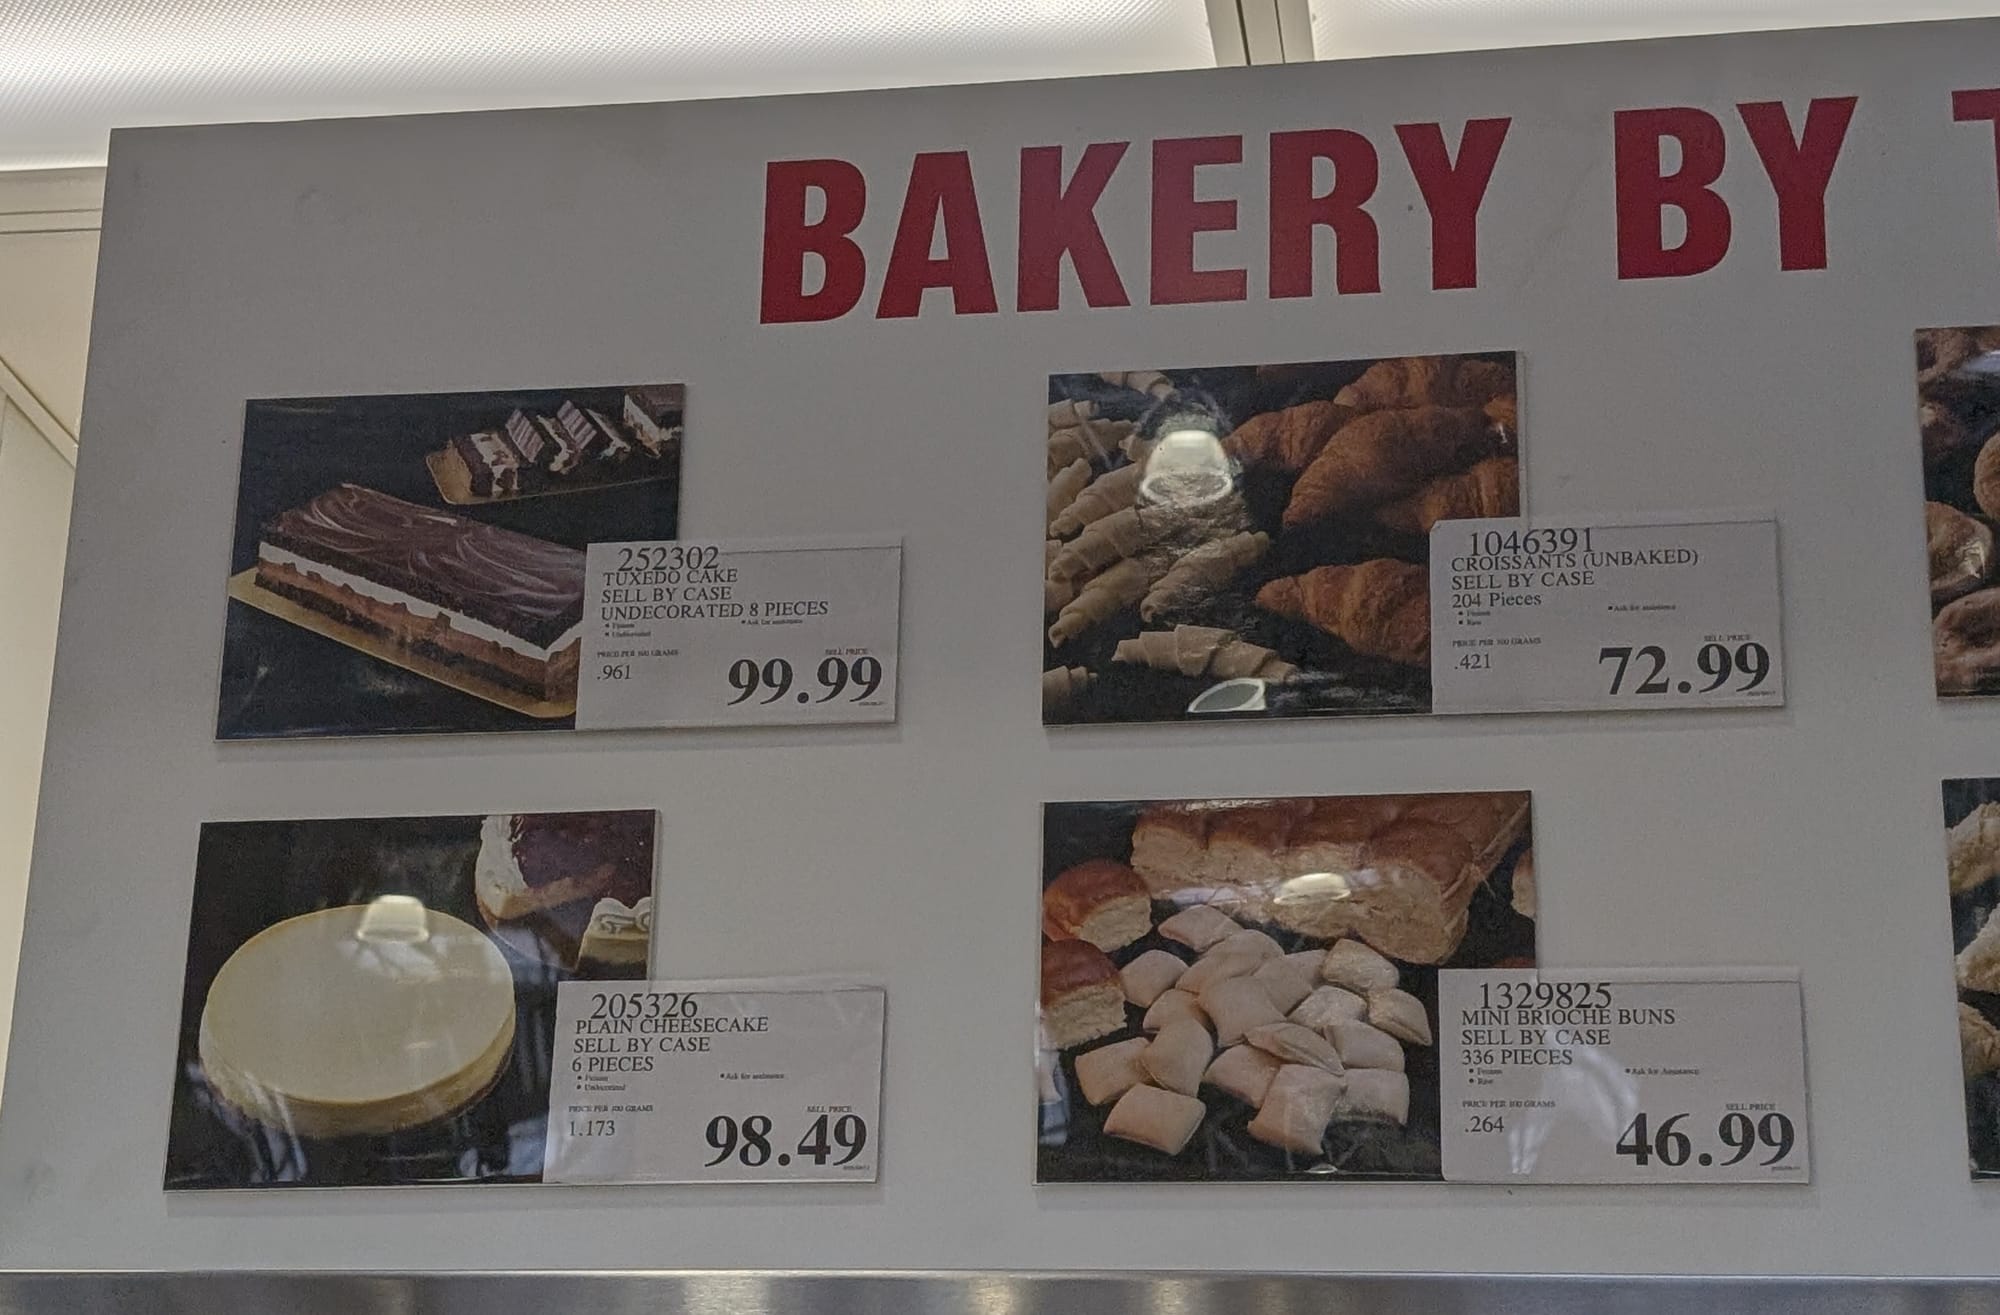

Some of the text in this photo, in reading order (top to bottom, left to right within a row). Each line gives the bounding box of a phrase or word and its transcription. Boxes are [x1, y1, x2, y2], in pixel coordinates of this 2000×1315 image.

[760, 117, 1512, 325] BAKERY
[1613, 96, 1858, 281] BY
[1470, 527, 1593, 557] 1046391
[617, 546, 720, 572] 252302
[1452, 550, 1698, 572] CROISSANTS (UNBAKED)
[603, 569, 738, 586] TUXEDO CAKE
[1452, 571, 1594, 590] SELL BY CASE
[601, 586, 732, 603] SELL BY CASE
[1452, 592, 1542, 609] 204 Pieces
[601, 601, 829, 621] UNDECORATED 8 PIECES
[1454, 652, 1491, 670] .421
[1598, 642, 1770, 695] 72.99
[597, 664, 632, 680] .961
[727, 657, 882, 706] 99.99
[590, 992, 698, 1019] 205326
[1480, 982, 1612, 1010] 1329825
[575, 1016, 769, 1035] PLAIN CHEESECAKE
[1462, 1008, 1676, 1026] MINI BRIOCHE BUNS
[573, 1036, 711, 1053] SELL BY CASE
[1462, 1028, 1611, 1046] SELL BY CASE
[572, 1056, 654, 1072] 6 PIECES
[1462, 1049, 1573, 1066] 336 PIECES
[570, 1120, 615, 1137] 1.173
[1464, 1115, 1504, 1133] .264
[704, 1114, 867, 1168] 98.49
[1616, 1112, 1795, 1167] 46.99
